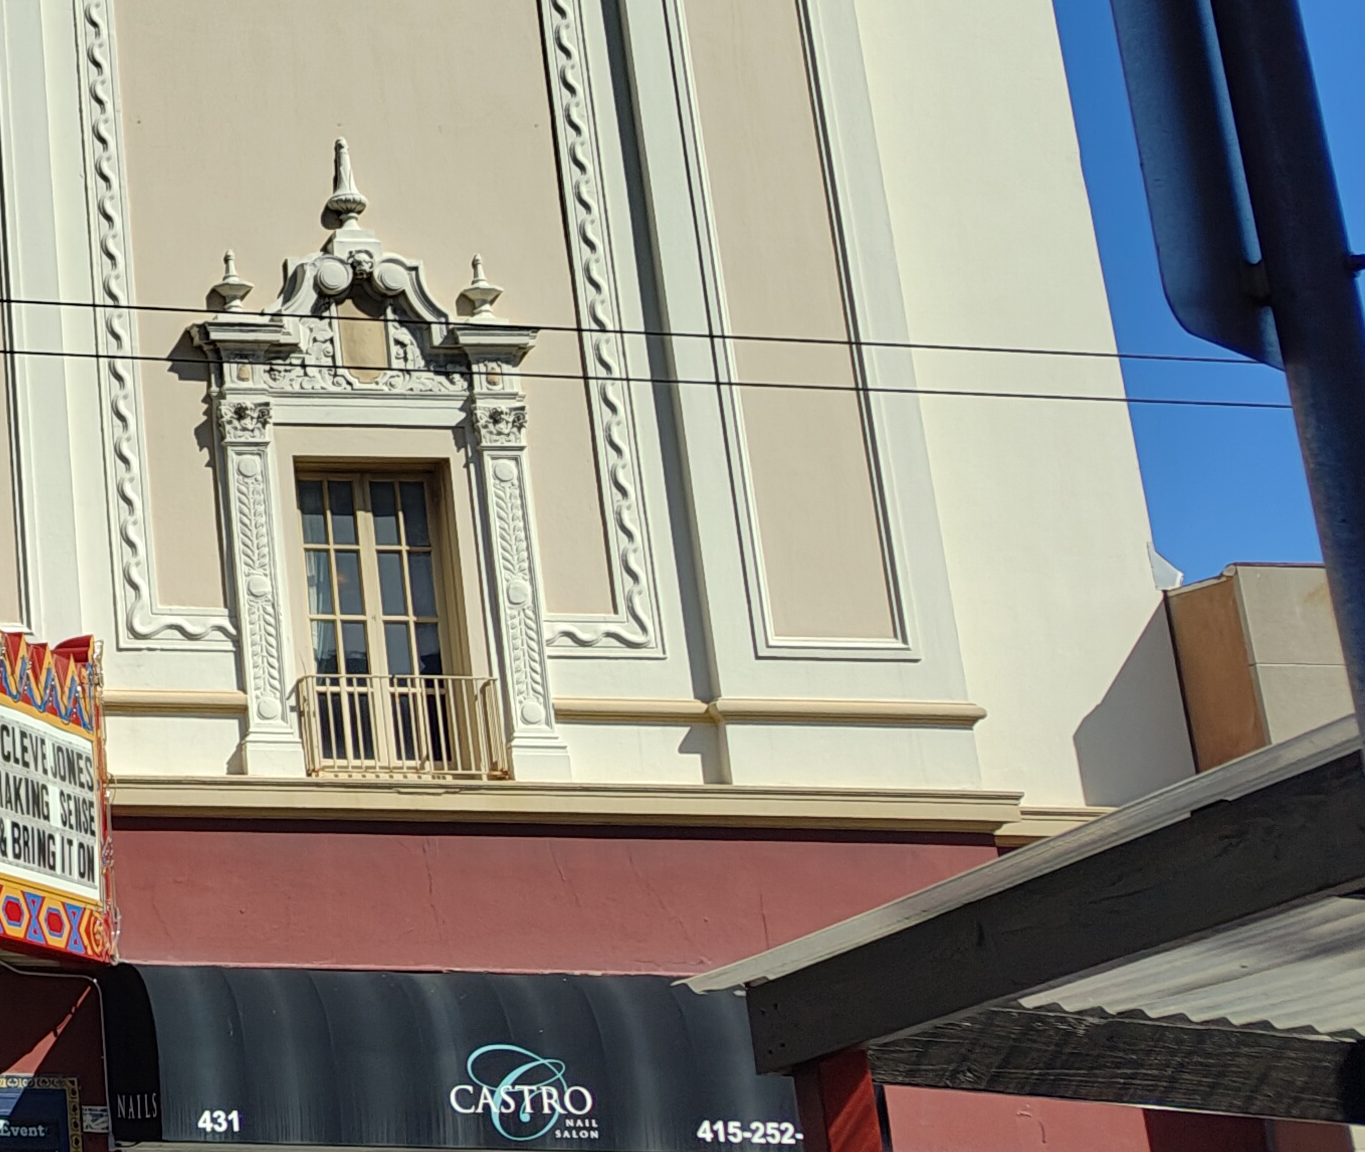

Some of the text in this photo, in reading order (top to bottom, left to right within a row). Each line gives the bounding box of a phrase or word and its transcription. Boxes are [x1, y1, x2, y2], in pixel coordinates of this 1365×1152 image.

[50, 743, 94, 792] JONES
[60, 789, 95, 837] SENSE
[0, 820, 8, 858] &
[12, 822, 56, 871] BRING
[61, 836, 73, 874] IT
[79, 842, 94, 883] ON
[117, 1092, 158, 1119] NAILS
[449, 1084, 593, 1115] CASTRO
[197, 1109, 240, 1133] 431
[555, 1129, 599, 1139] SALON
[565, 1119, 598, 1128] NAIL
[696, 1120, 804, 1145] 415-252-
